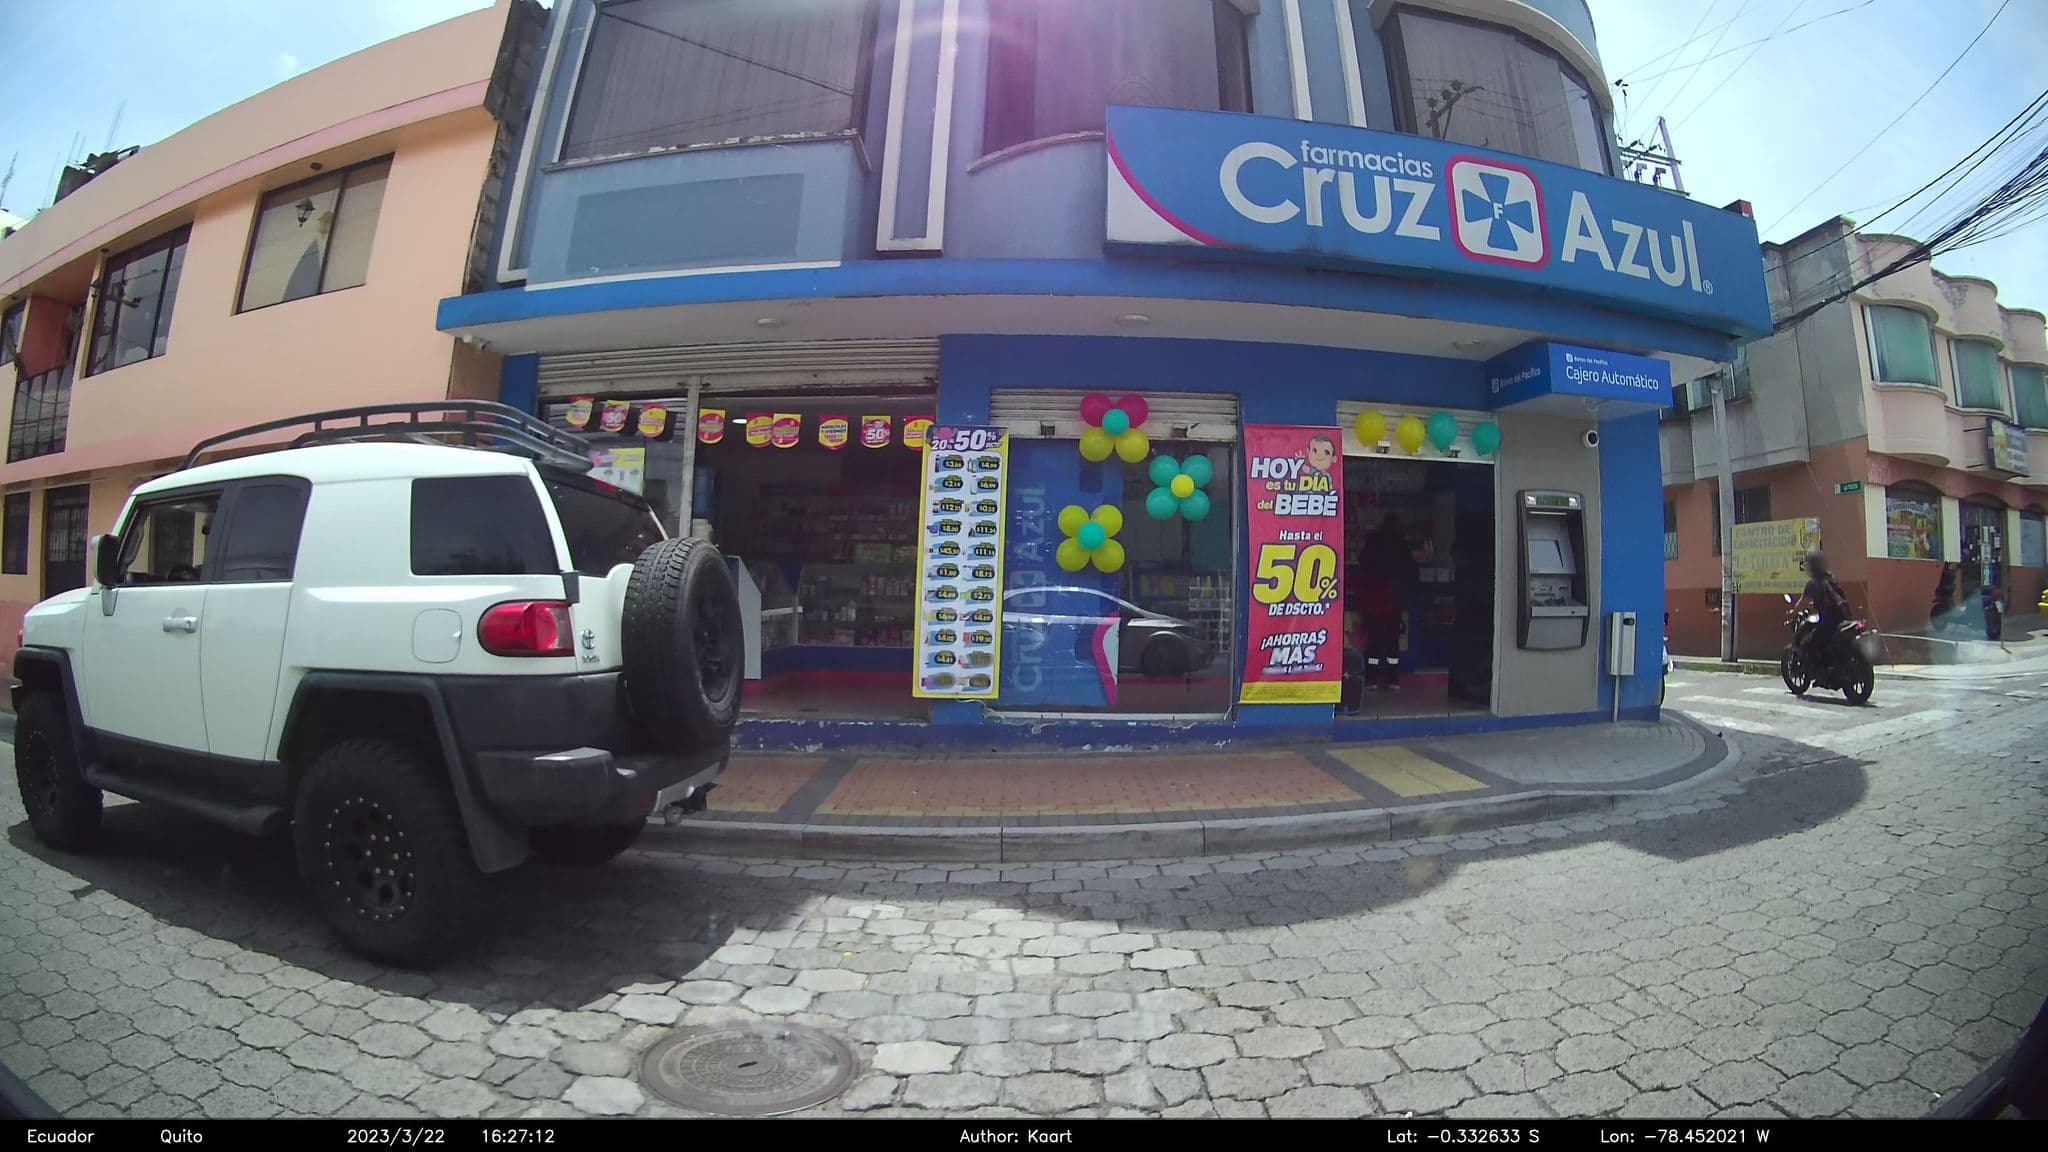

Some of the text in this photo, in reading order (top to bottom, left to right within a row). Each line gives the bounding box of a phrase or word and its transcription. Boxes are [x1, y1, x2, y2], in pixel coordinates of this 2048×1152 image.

[1301, 140, 1433, 178] farmacias
[1220, 142, 1702, 292] Cruz Azul
[1493, 202, 1504, 220] F
[1566, 366, 1659, 390] Cajero Automático
[1251, 457, 1304, 479] HOY
[1266, 473, 1330, 492] es tu DÍA
[1257, 491, 1338, 516] del BEBÉ
[1279, 530, 1323, 541] Hasta el
[1253, 544, 1338, 604] 50%
[1268, 603, 1284, 616] DE
